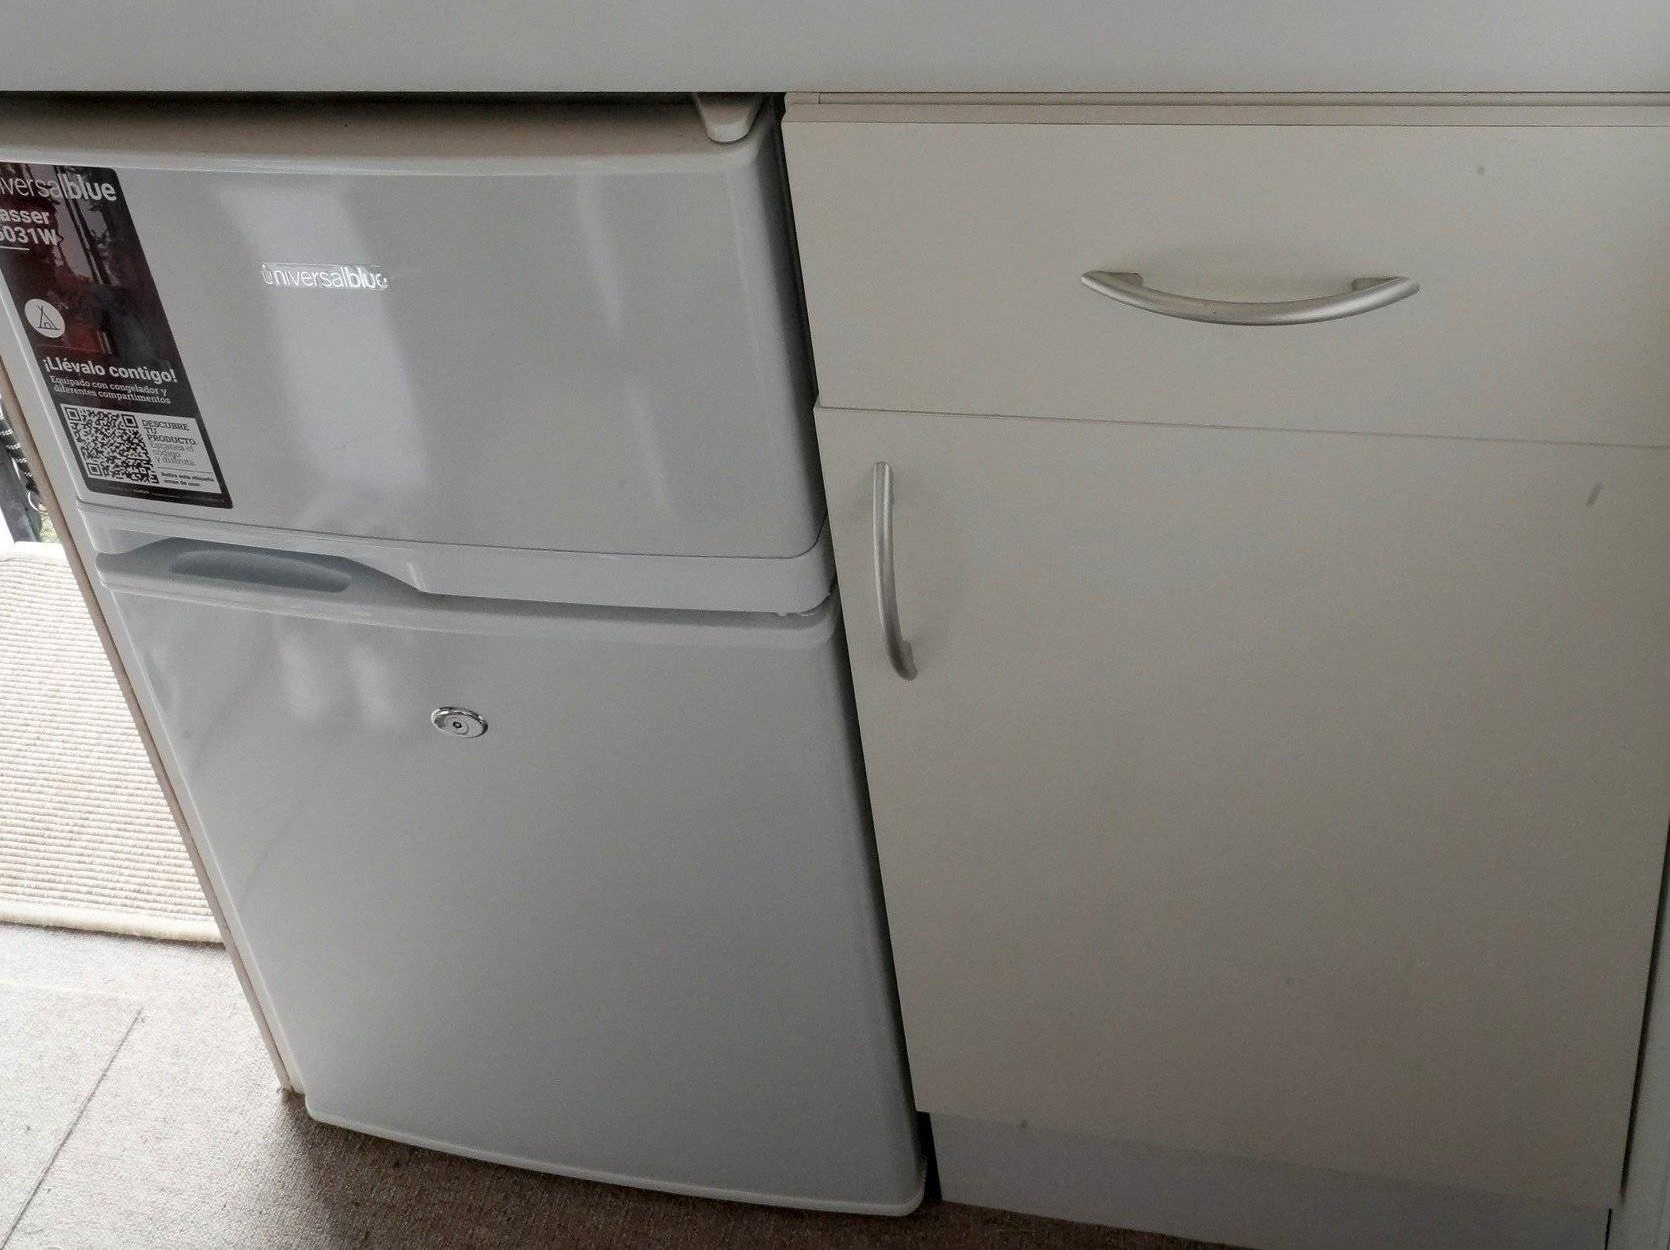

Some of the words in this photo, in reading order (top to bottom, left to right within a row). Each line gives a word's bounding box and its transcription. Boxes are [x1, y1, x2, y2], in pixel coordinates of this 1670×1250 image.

[42, 356, 106, 376] ¡Llévalo
[109, 366, 177, 385] contigo!
[49, 375, 91, 388] Equipado
[92, 380, 109, 389] con
[109, 382, 159, 395] congelador
[160, 388, 167, 397] y
[53, 384, 98, 397] diferentes
[98, 390, 171, 404] compartimentos
[141, 419, 190, 431] DESCUBRE
